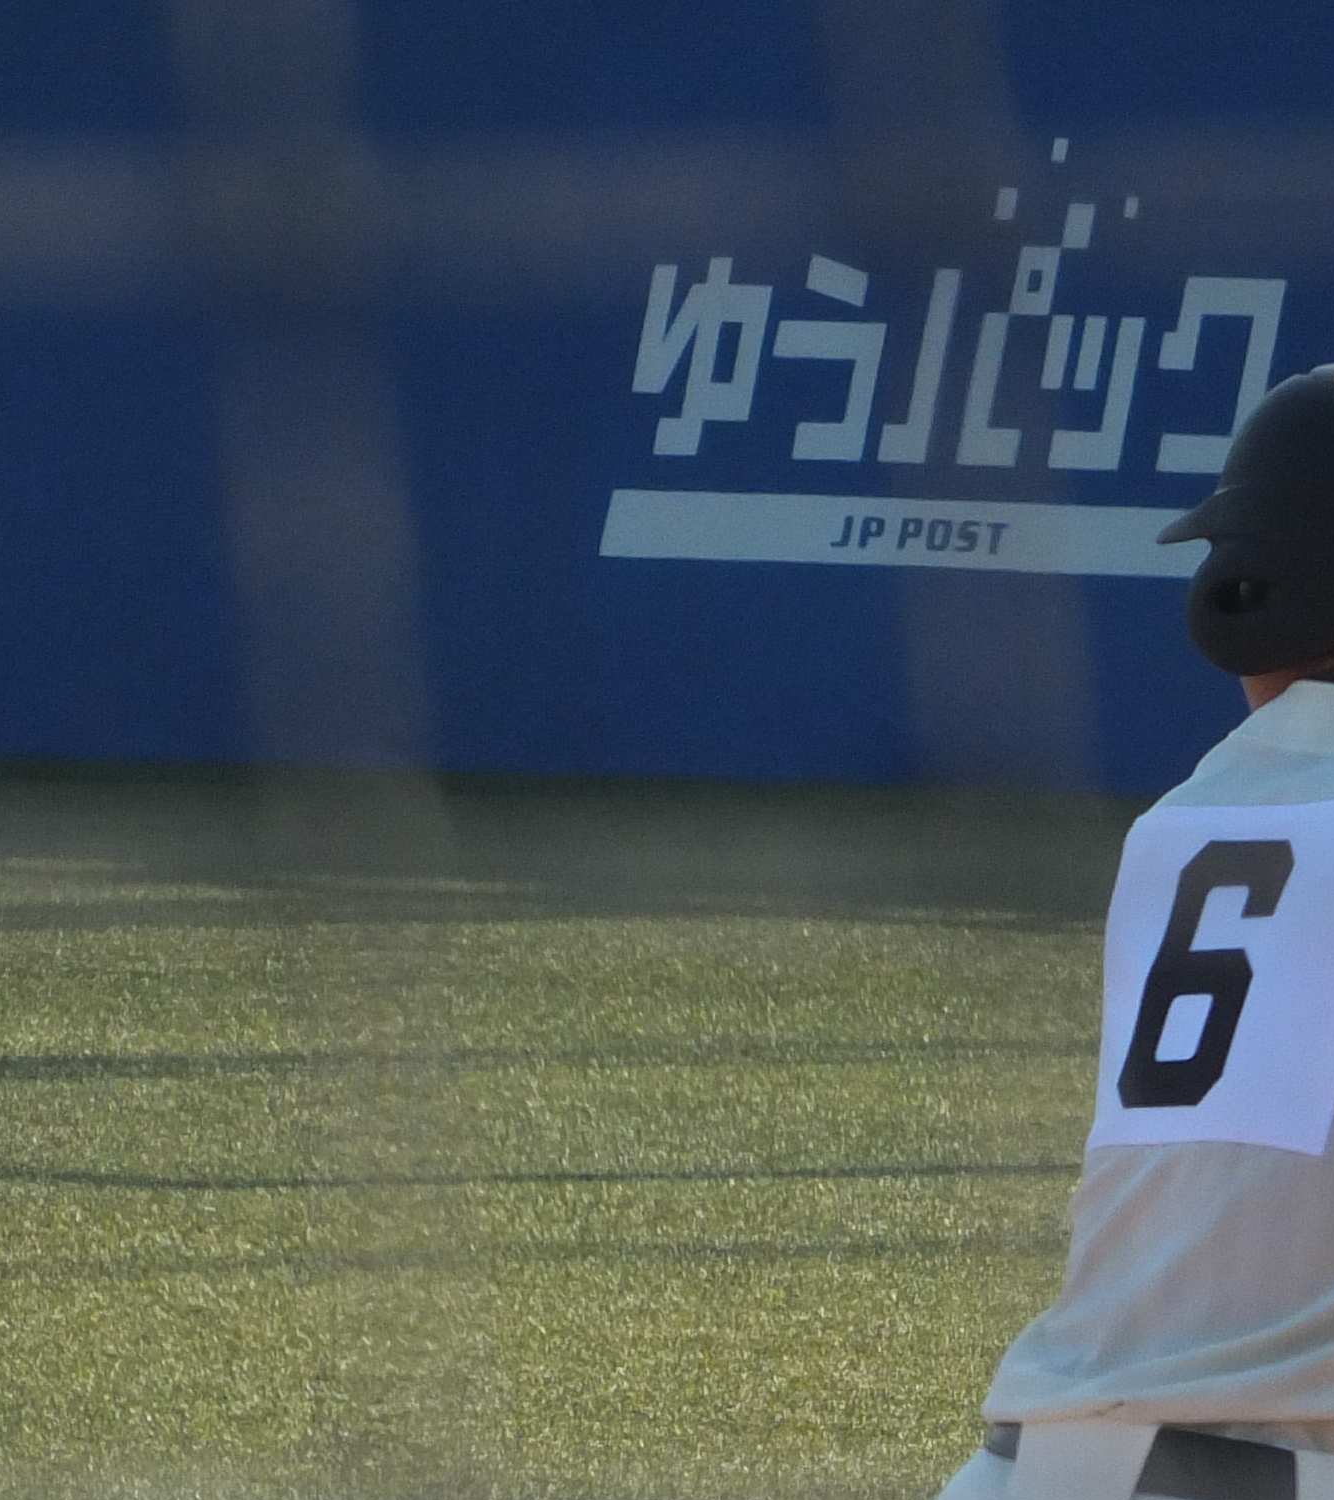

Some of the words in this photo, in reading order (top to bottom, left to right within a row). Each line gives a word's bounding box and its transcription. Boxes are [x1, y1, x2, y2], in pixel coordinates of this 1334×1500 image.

[631, 204, 1287, 474] ゆうパック
[830, 515, 885, 549] JP
[897, 517, 1009, 555] POST
[1117, 839, 1295, 1109] 6
